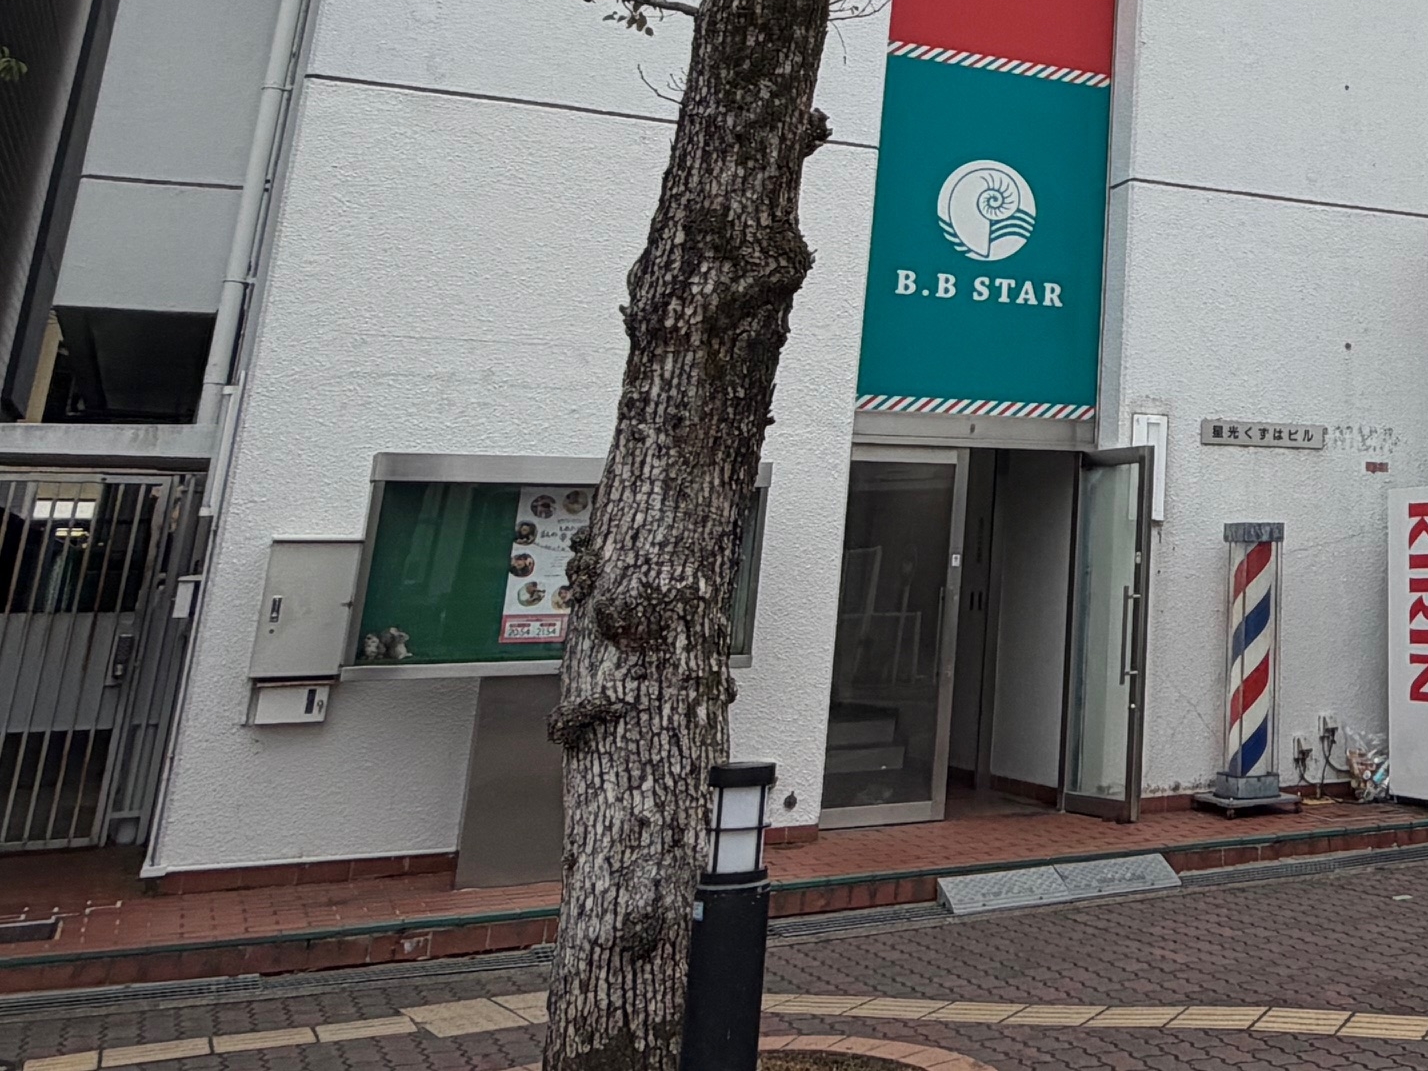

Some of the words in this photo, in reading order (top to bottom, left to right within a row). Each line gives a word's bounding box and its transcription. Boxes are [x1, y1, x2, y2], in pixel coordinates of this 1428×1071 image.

[895, 269, 956, 298] B.B
[972, 276, 1063, 307] STAR
[1212, 425, 1314, 443] 星光くずはビル
